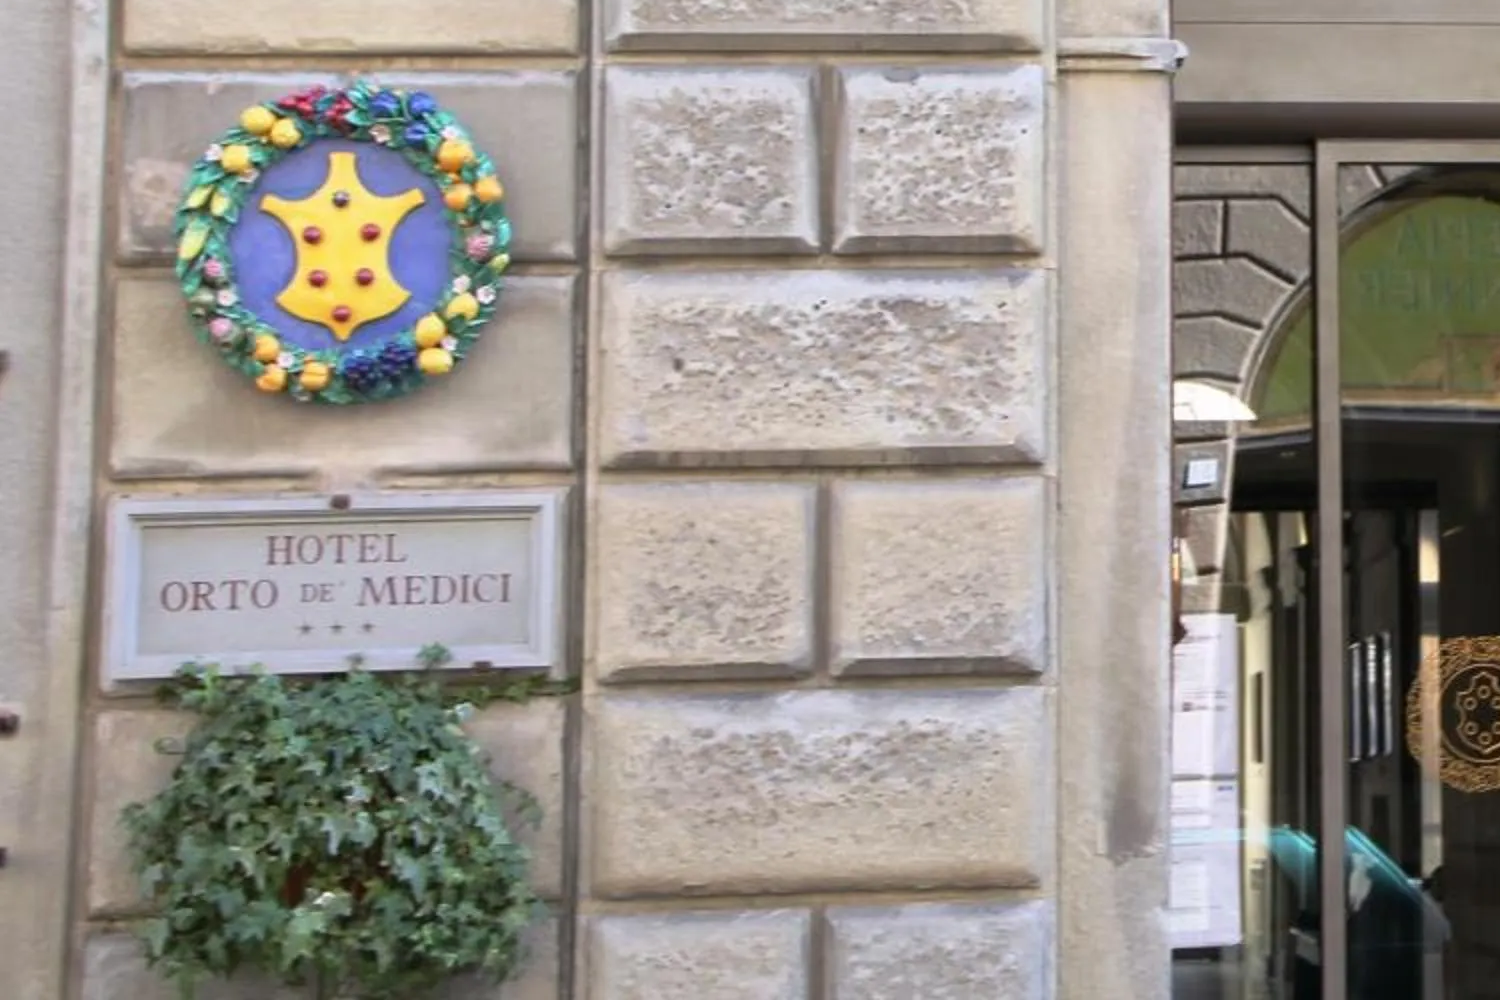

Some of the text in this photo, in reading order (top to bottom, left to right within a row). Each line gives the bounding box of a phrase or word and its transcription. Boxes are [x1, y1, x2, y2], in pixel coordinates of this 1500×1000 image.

[264, 533, 408, 566] HOTEL
[160, 578, 280, 613] ORTO
[356, 572, 513, 608] MEDICI
